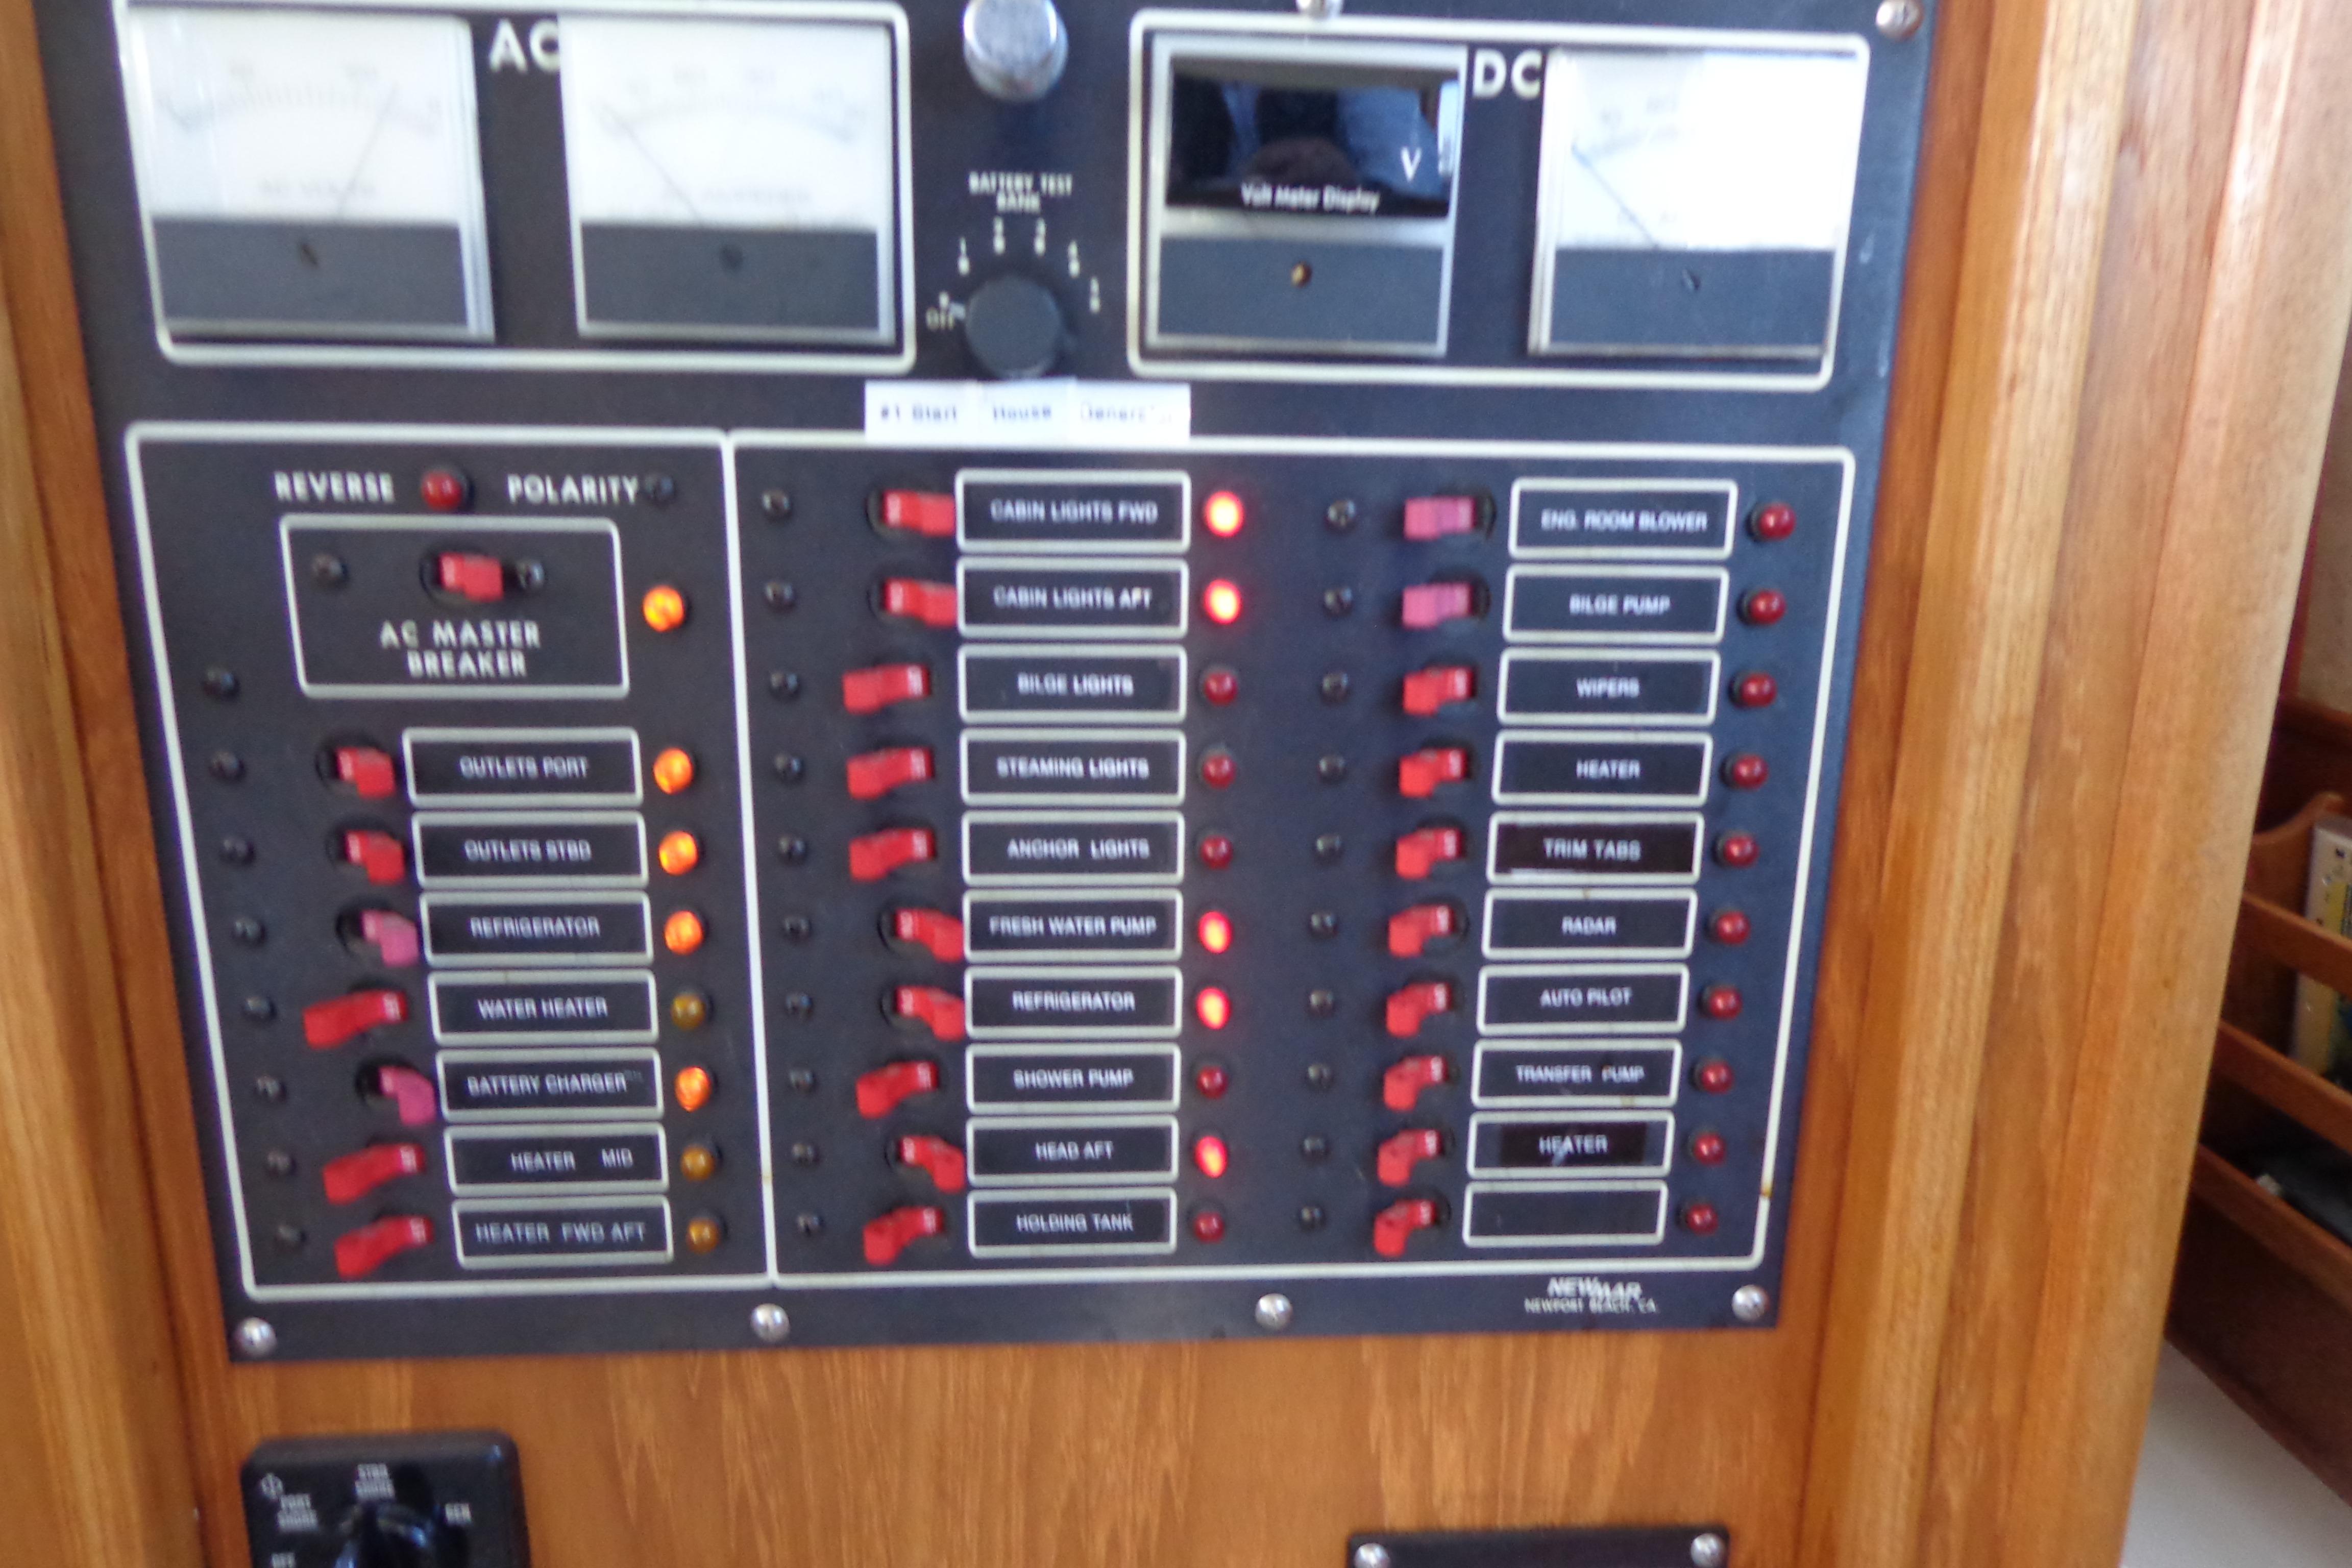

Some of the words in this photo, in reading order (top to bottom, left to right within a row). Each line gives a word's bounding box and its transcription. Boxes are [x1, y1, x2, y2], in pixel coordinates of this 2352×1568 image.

[489, 19, 559, 74] AC
[1472, 48, 1542, 99] DC
[1401, 147, 1422, 182] V
[274, 471, 395, 503] REVERSE
[507, 474, 639, 504] POLARITY
[990, 499, 1045, 522] CABIN
[1051, 500, 1113, 523] LIGHTS
[1584, 509, 1634, 531] ROOM
[1638, 510, 1708, 532] BLOWER
[993, 586, 1047, 608] CABIN
[1054, 587, 1115, 609] LIGHTS
[1623, 594, 1671, 616] PUMP
[380, 620, 419, 648] AC
[432, 621, 540, 648] MASTER
[407, 650, 526, 678] BREAKER
[1073, 674, 1134, 697] LIGHTS
[459, 755, 538, 779] OUTLETS
[542, 756, 588, 778] PORT
[996, 756, 1084, 779] STEAMING
[1089, 757, 1149, 779] LIGHTS
[1575, 760, 1641, 779] HEATER
[463, 839, 542, 862] OUTLETS
[1007, 838, 1080, 860] ANCHOR
[1090, 838, 1149, 860] LIGHTS
[1542, 837, 1588, 861] TRIM
[1593, 839, 1642, 862] TABS
[470, 916, 601, 938] REFRIGERATOR
[989, 916, 1044, 936] FRESH
[1048, 916, 1106, 937] WATER
[1111, 917, 1157, 937] PUMP
[1561, 916, 1616, 936] RADAR
[477, 997, 537, 1020] WATER
[541, 997, 608, 1018] HEATER
[1012, 991, 1136, 1012] REFRIGERATOR
[1539, 988, 1582, 1008] AUTO
[1586, 987, 1633, 1007] PILOT
[467, 1074, 540, 1096] BATTERY
[545, 1072, 627, 1095] CHARGER
[1013, 1069, 1084, 1089] SHOWER
[1089, 1068, 1134, 1088] PUMP
[1515, 1065, 1592, 1084] TRANSFER
[1602, 1065, 1645, 1083] PUMP
[1035, 1141, 1079, 1161] HEAD
[1083, 1140, 1114, 1160] AFT
[1538, 1135, 1608, 1155] HEATER
[510, 1150, 576, 1172] HEATER
[475, 1223, 550, 1243] HEATER
[610, 1221, 646, 1242] AFT
[1016, 1214, 1088, 1233] HOLDING
[1093, 1212, 1133, 1231] TANK
